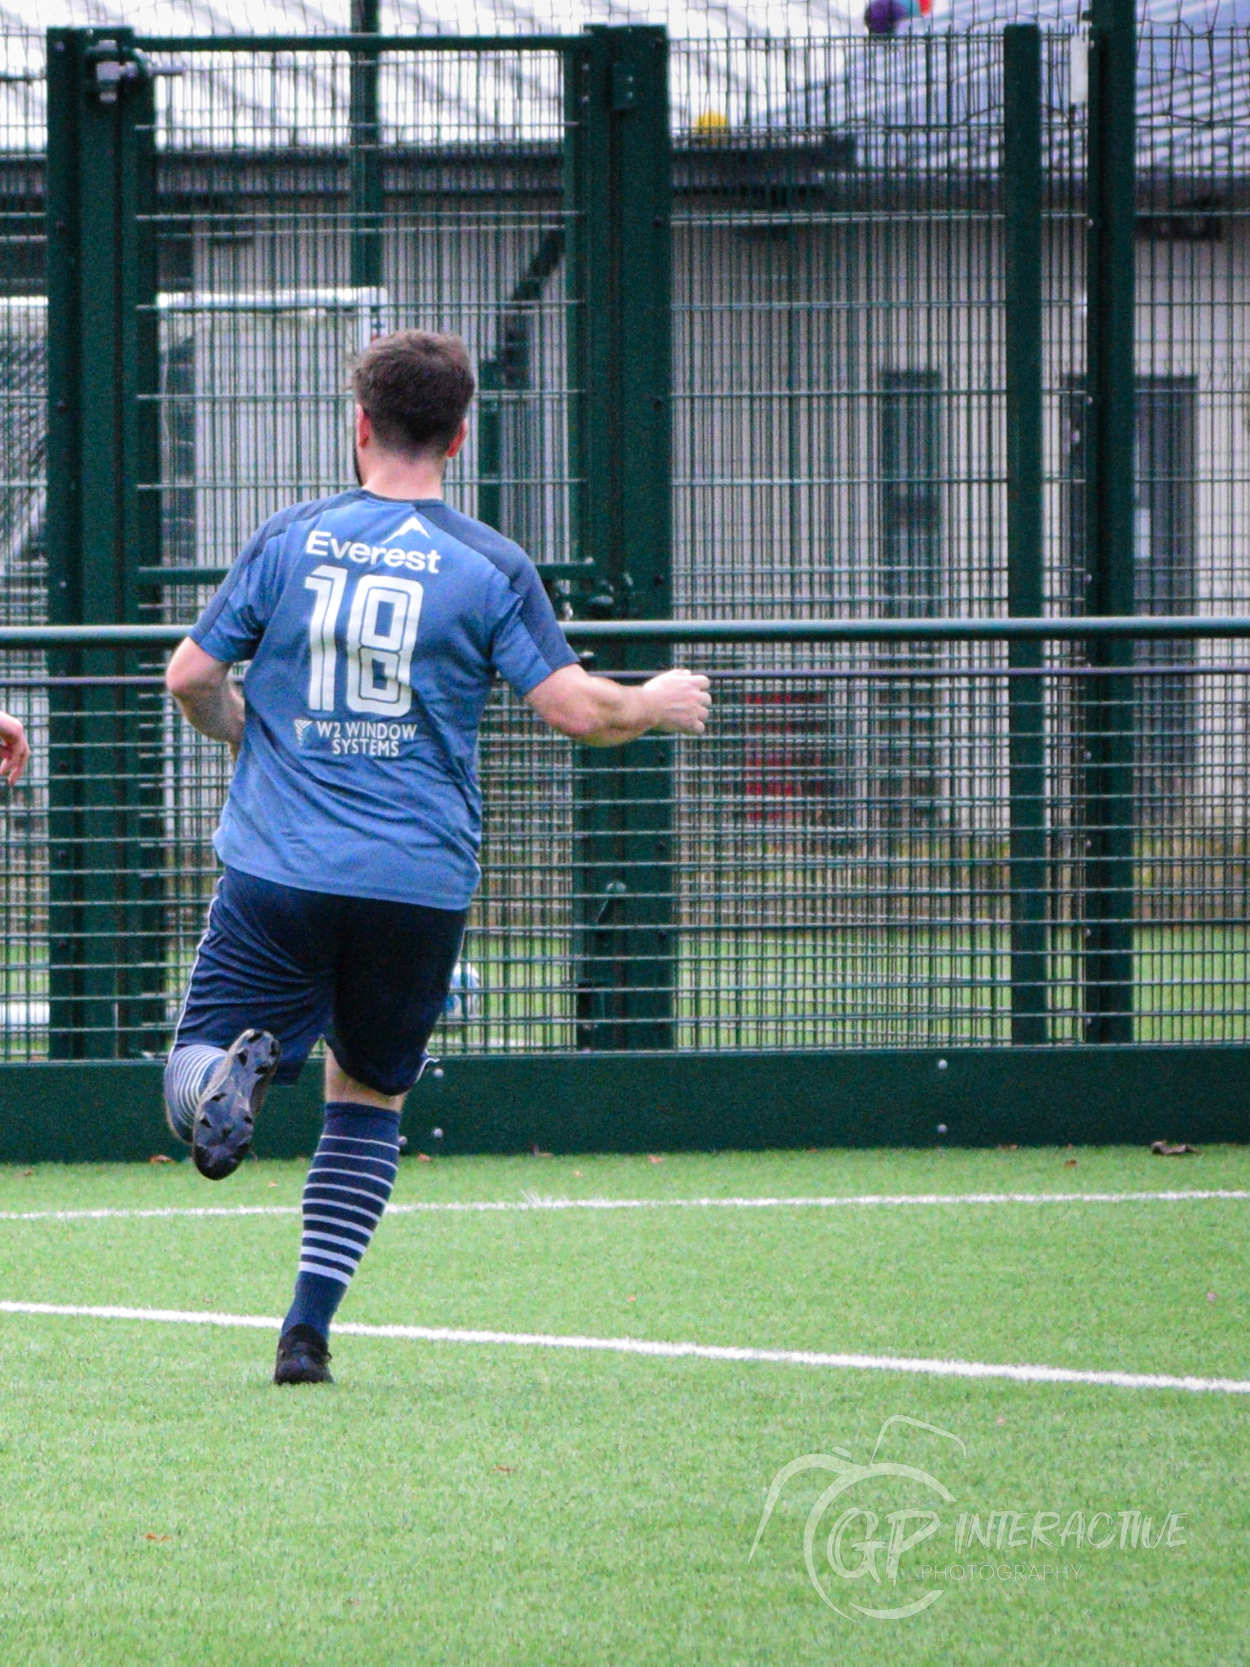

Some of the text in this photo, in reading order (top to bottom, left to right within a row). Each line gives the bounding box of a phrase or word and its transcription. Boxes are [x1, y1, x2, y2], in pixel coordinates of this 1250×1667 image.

[305, 530, 442, 574] Everest
[304, 564, 424, 717] 18
[316, 721, 418, 740] W2 WINDOW
[332, 739, 400, 757] SYSTEMS
